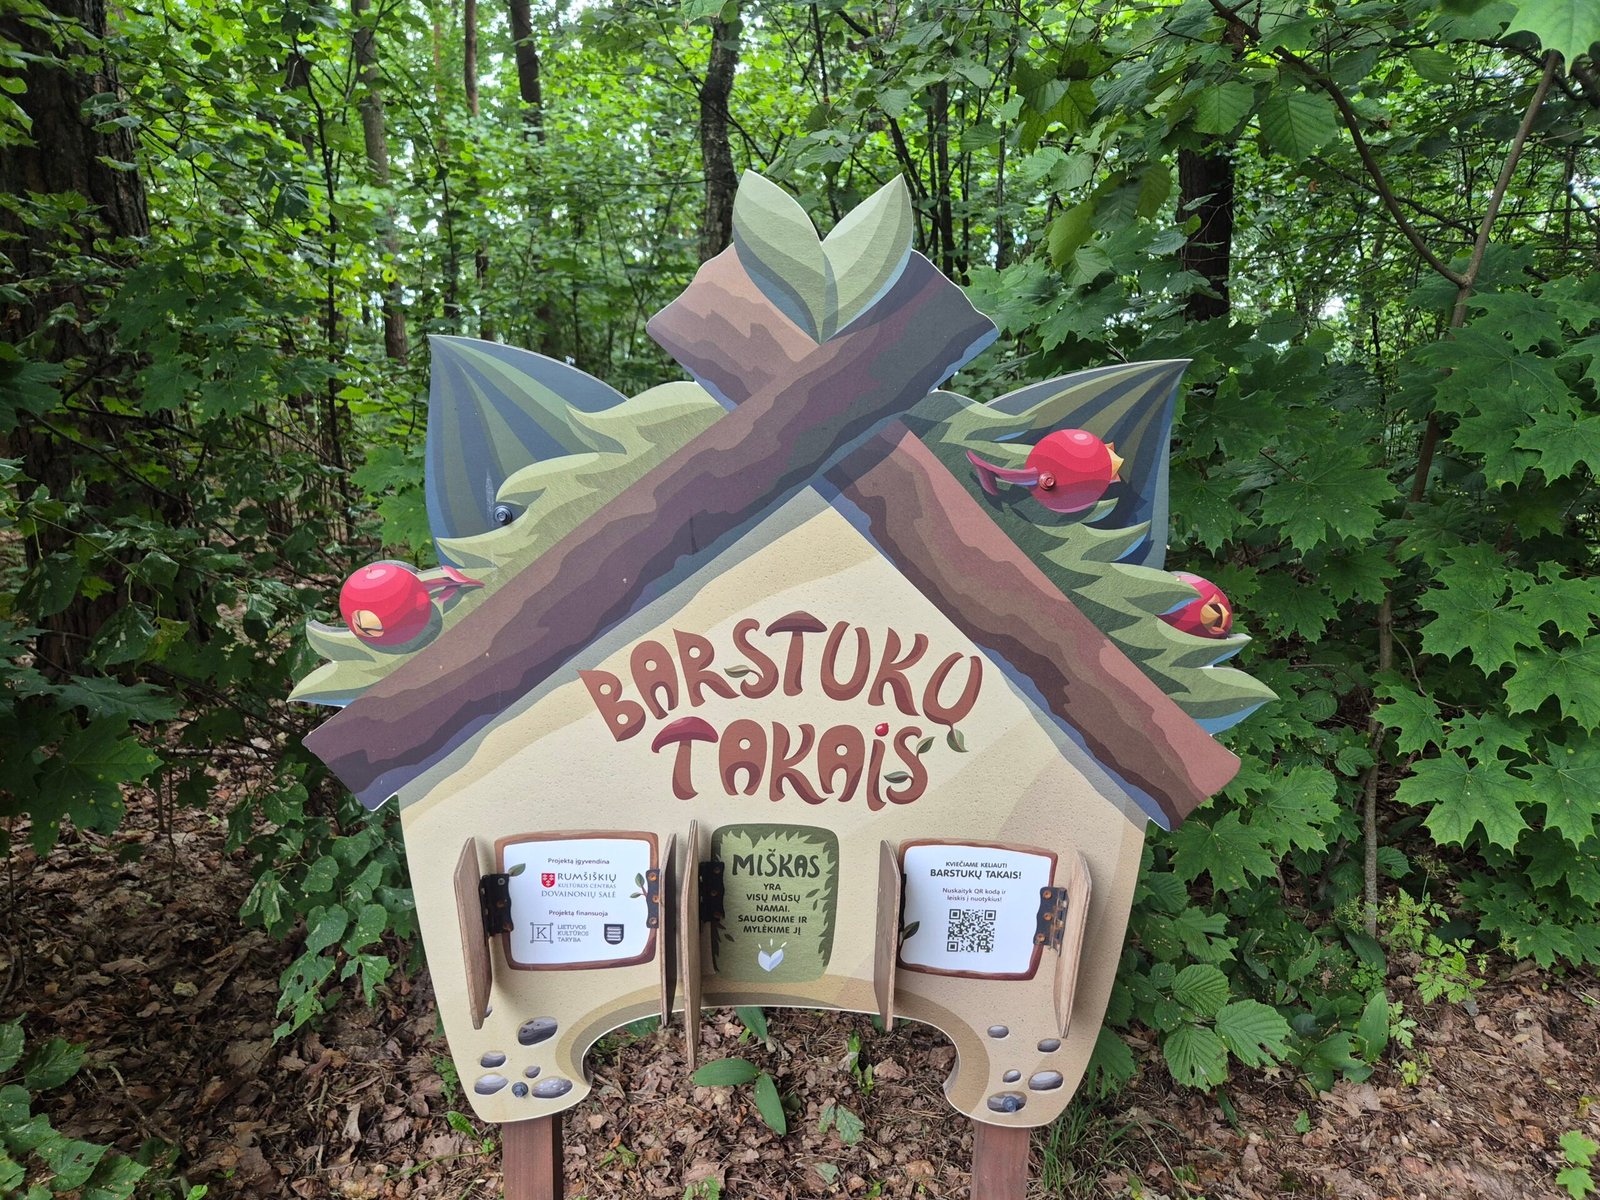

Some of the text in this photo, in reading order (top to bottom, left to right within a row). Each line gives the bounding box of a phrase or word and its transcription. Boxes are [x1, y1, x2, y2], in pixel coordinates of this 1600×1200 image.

[732, 848, 820, 878] MIŠKAS
[557, 872, 616, 883] RUMŠIŠKIŲ
[930, 868, 1022, 880] BARSTUKŲ TAKAIS!
[541, 890, 596, 899] DOVAINONIŲ
[942, 887, 972, 895] Nuskaityk
[746, 892, 800, 903] VISŲ MŪSŲ
[576, 909, 608, 917] finansuoja
[756, 904, 790, 913] NAMAI.
[738, 914, 794, 923] SAUGOKIME
[536, 927, 547, 939] K
[743, 924, 790, 933] MYLĖKIME
